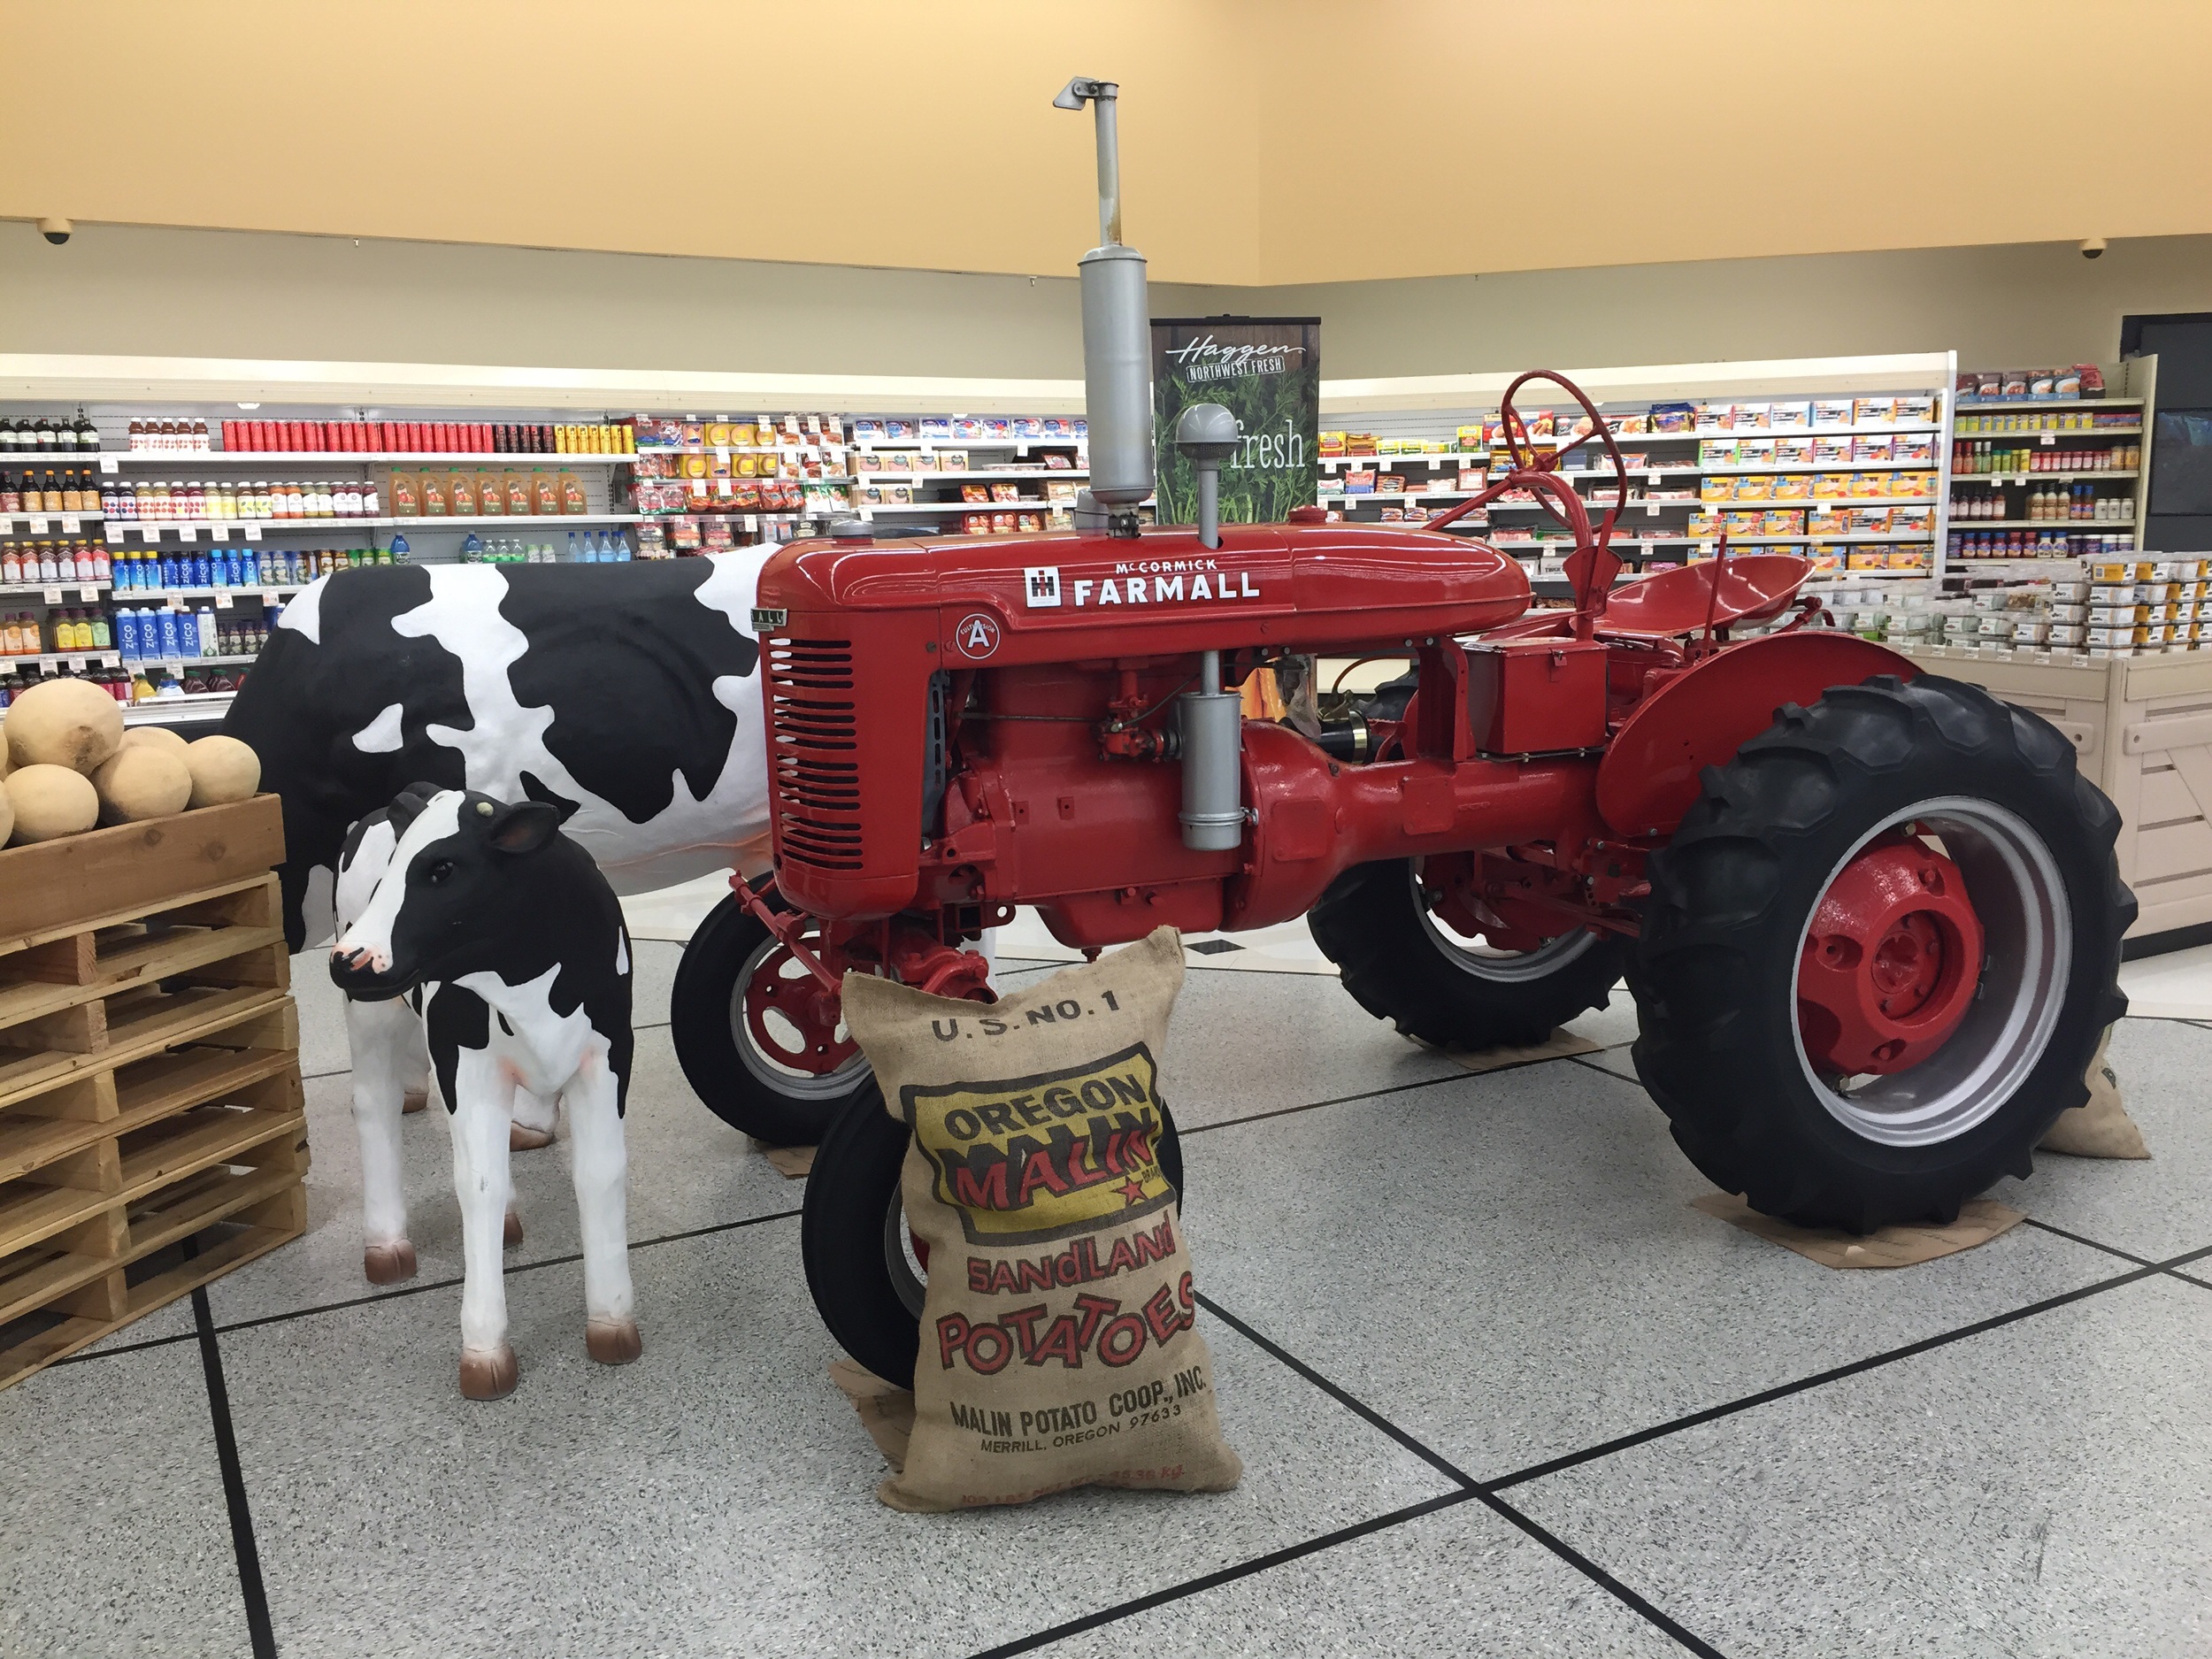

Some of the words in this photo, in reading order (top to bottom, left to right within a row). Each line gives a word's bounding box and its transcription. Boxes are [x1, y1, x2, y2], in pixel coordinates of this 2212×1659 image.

[1165, 334, 1306, 365] Haggen
[1188, 361, 1248, 380] NORTHWEST
[1251, 357, 1282, 373] FRESH
[1073, 572, 1260, 606] FARMALL
[122, 625, 134, 649] zico
[142, 624, 154, 649] zico
[163, 622, 175, 646] zico
[182, 622, 195, 647] zico
[967, 619, 990, 648] A
[943, 1073, 1148, 1141] OREGON
[947, 1120, 1158, 1211] MALIN
[935, 1271, 1195, 1376] POTATOES
[949, 1401, 1012, 1438] MALIN
[1021, 1401, 1097, 1436] POTATO
[1175, 1365, 1207, 1398] INC.
[1053, 1421, 1120, 1448] OREGON
[1129, 1404, 1182, 1430] 97633
